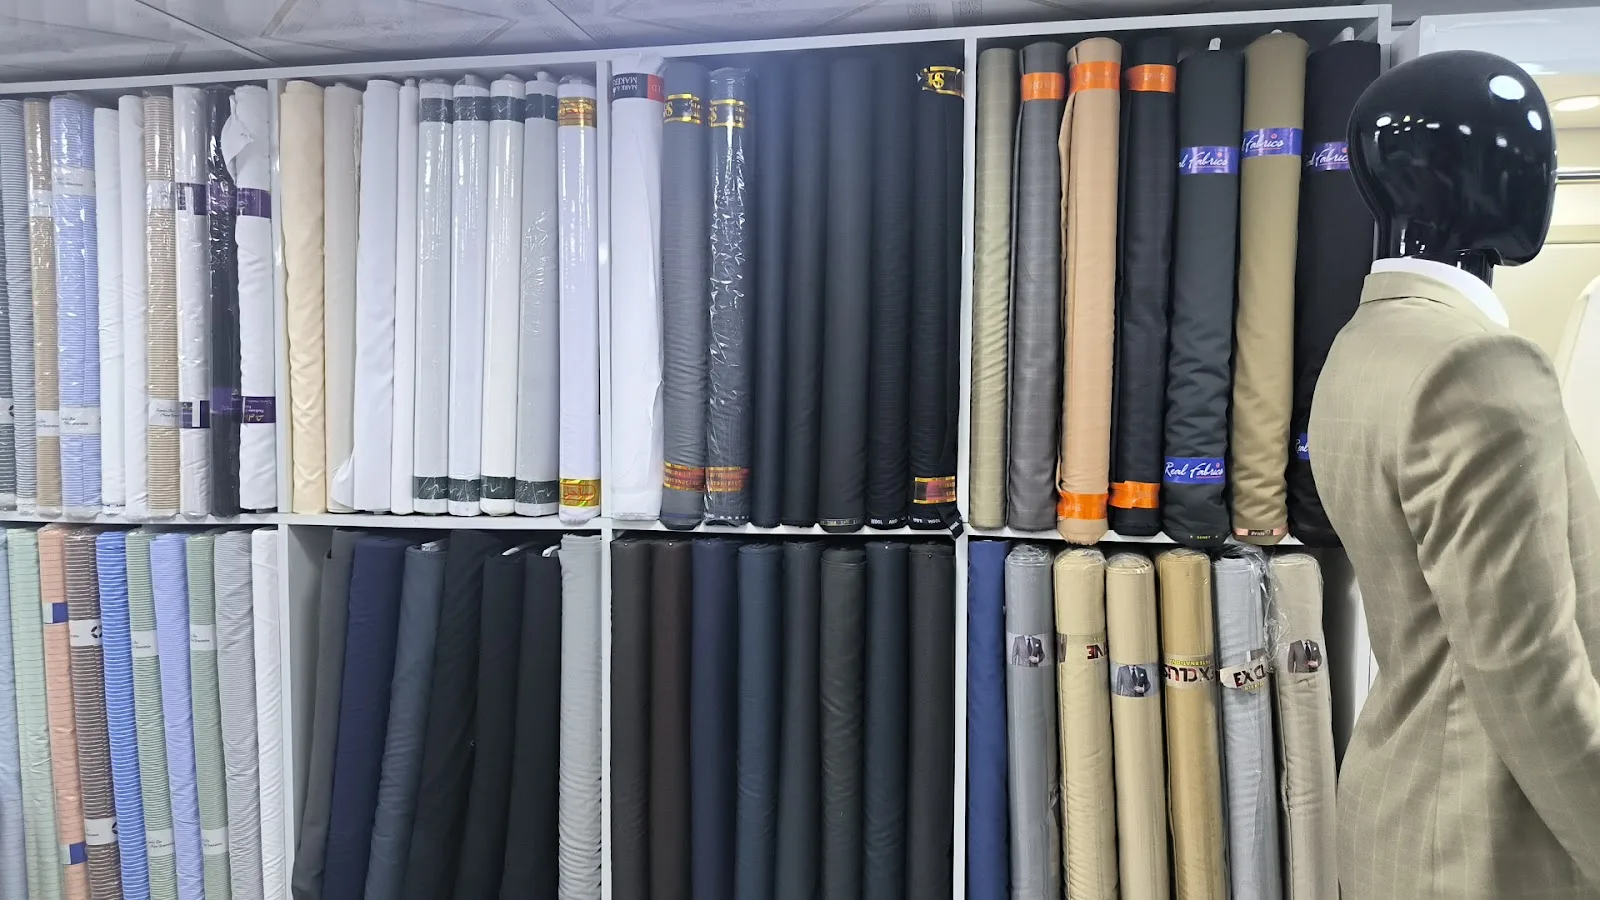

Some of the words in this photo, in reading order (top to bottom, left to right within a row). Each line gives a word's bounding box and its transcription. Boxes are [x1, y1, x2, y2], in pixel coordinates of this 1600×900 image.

[1245, 133, 1285, 153] Fabrics
[1188, 151, 1228, 169] Fabrics
[1164, 461, 1189, 478] Real
[1189, 462, 1224, 479] Fabrics
